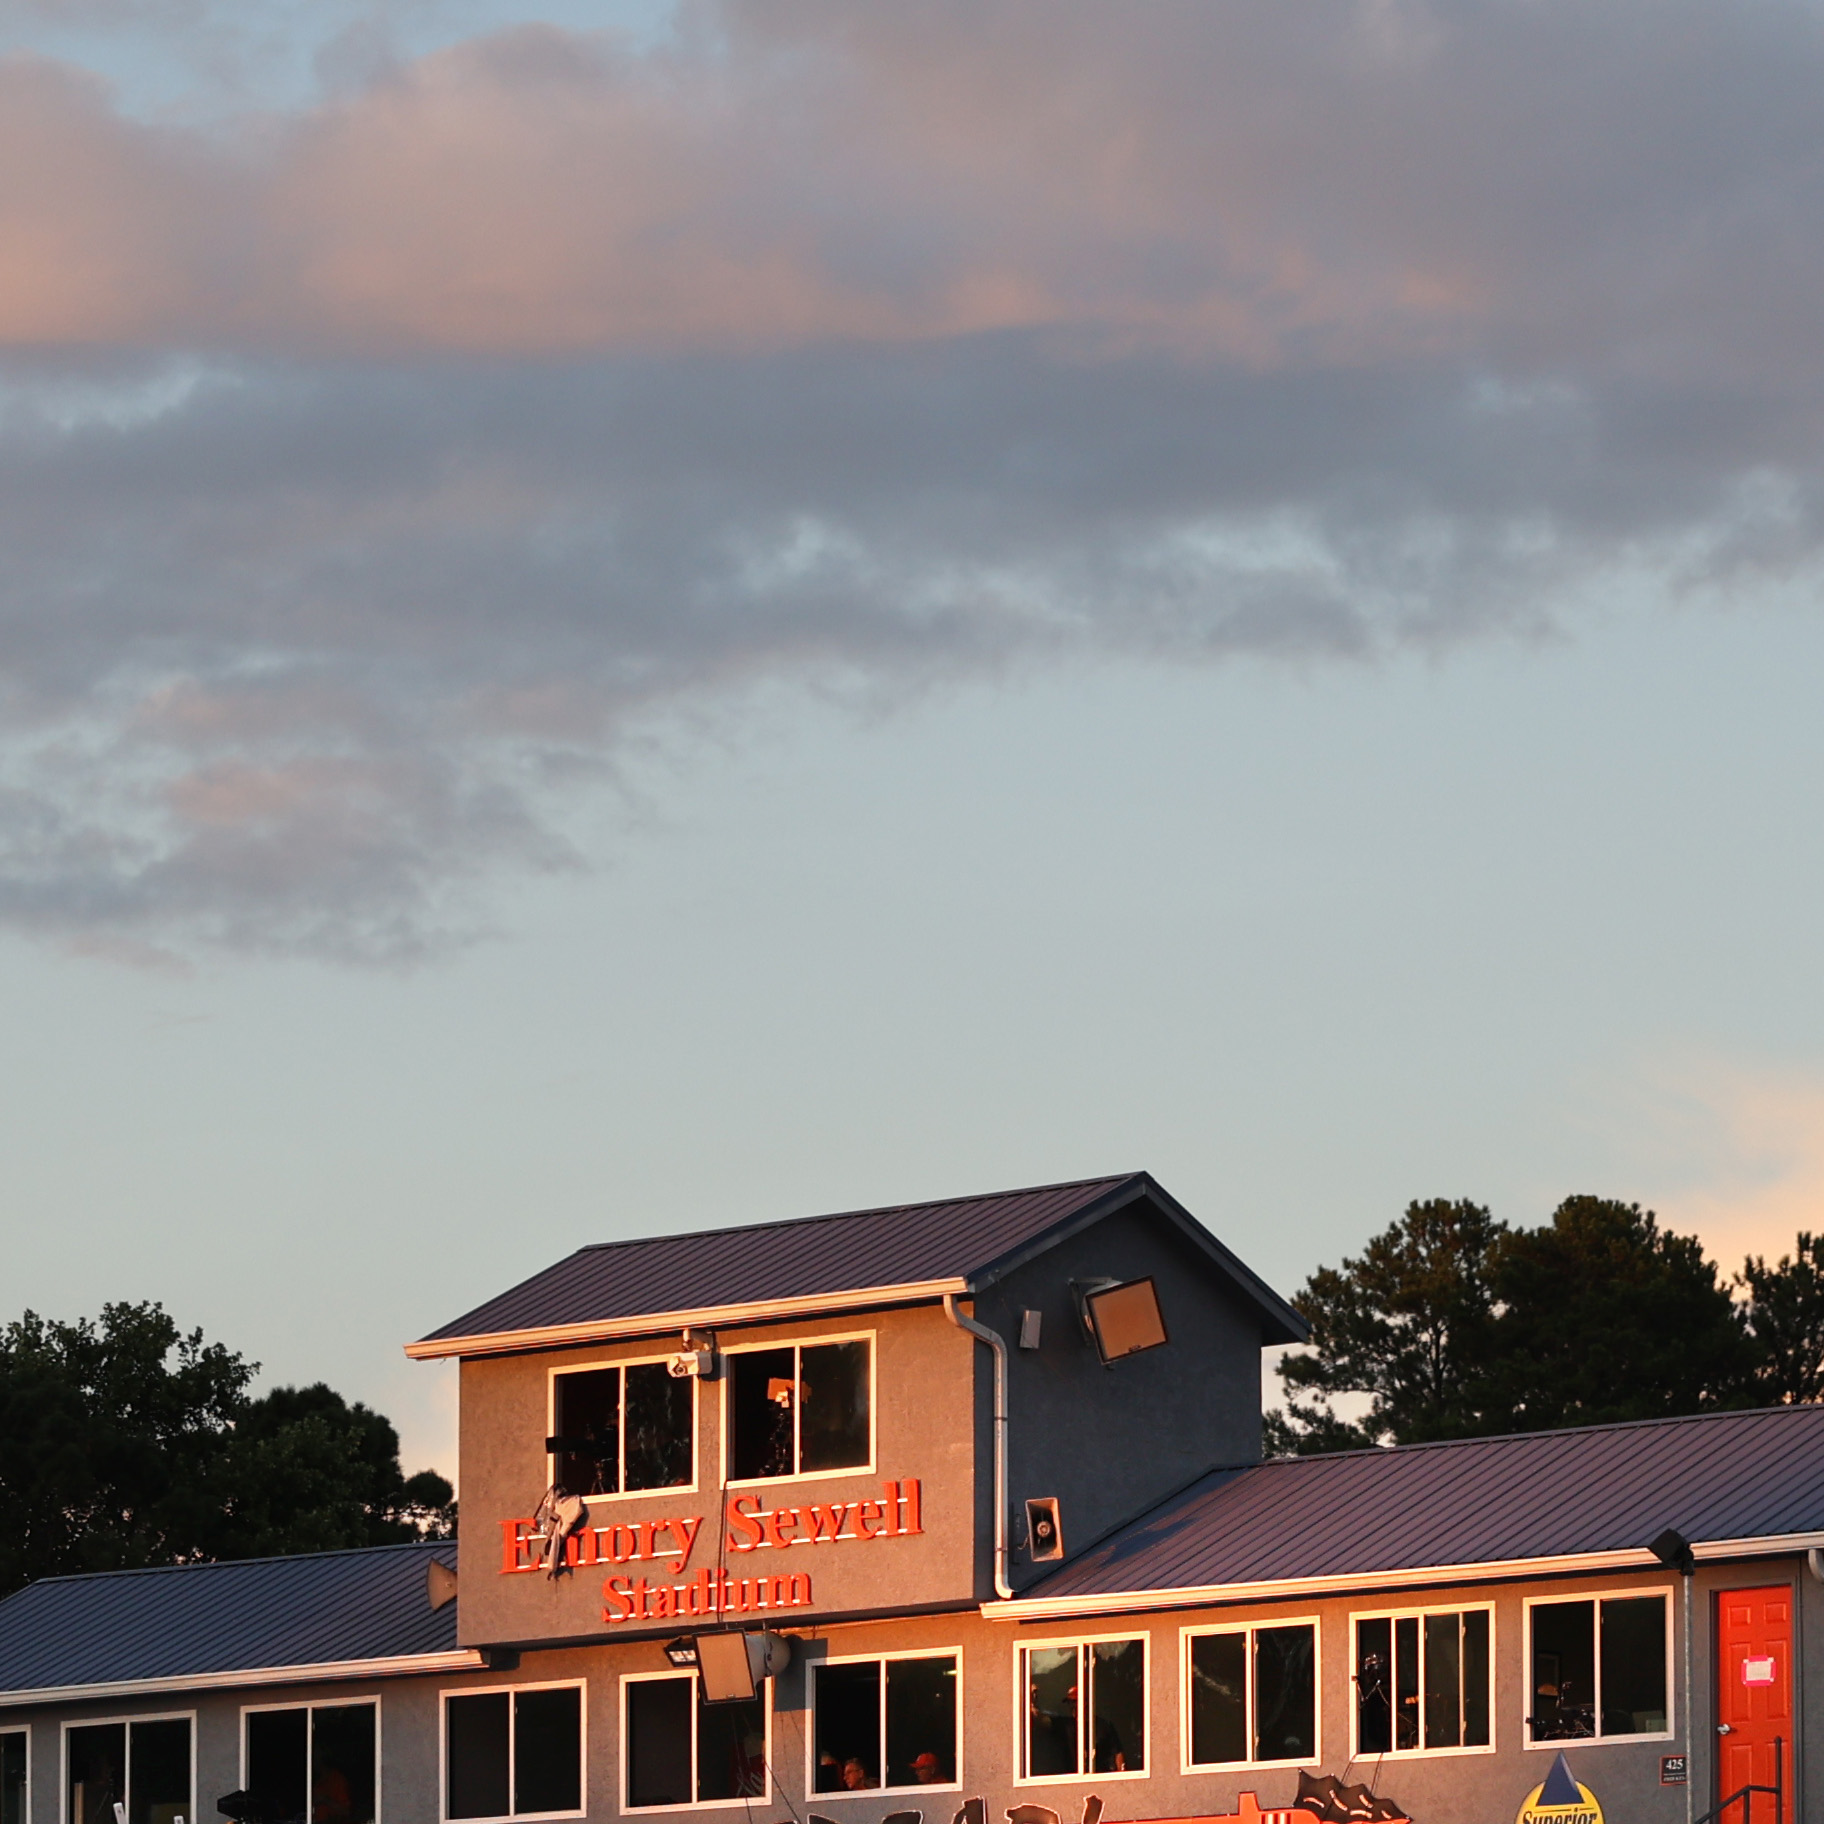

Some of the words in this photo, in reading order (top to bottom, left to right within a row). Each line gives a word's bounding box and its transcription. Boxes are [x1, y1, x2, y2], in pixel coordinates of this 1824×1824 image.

[497, 1515, 703, 1574] Emory
[726, 1479, 923, 1553] Sewell
[602, 1568, 812, 1622] Stadium
[1666, 1758, 1683, 1770] 425
